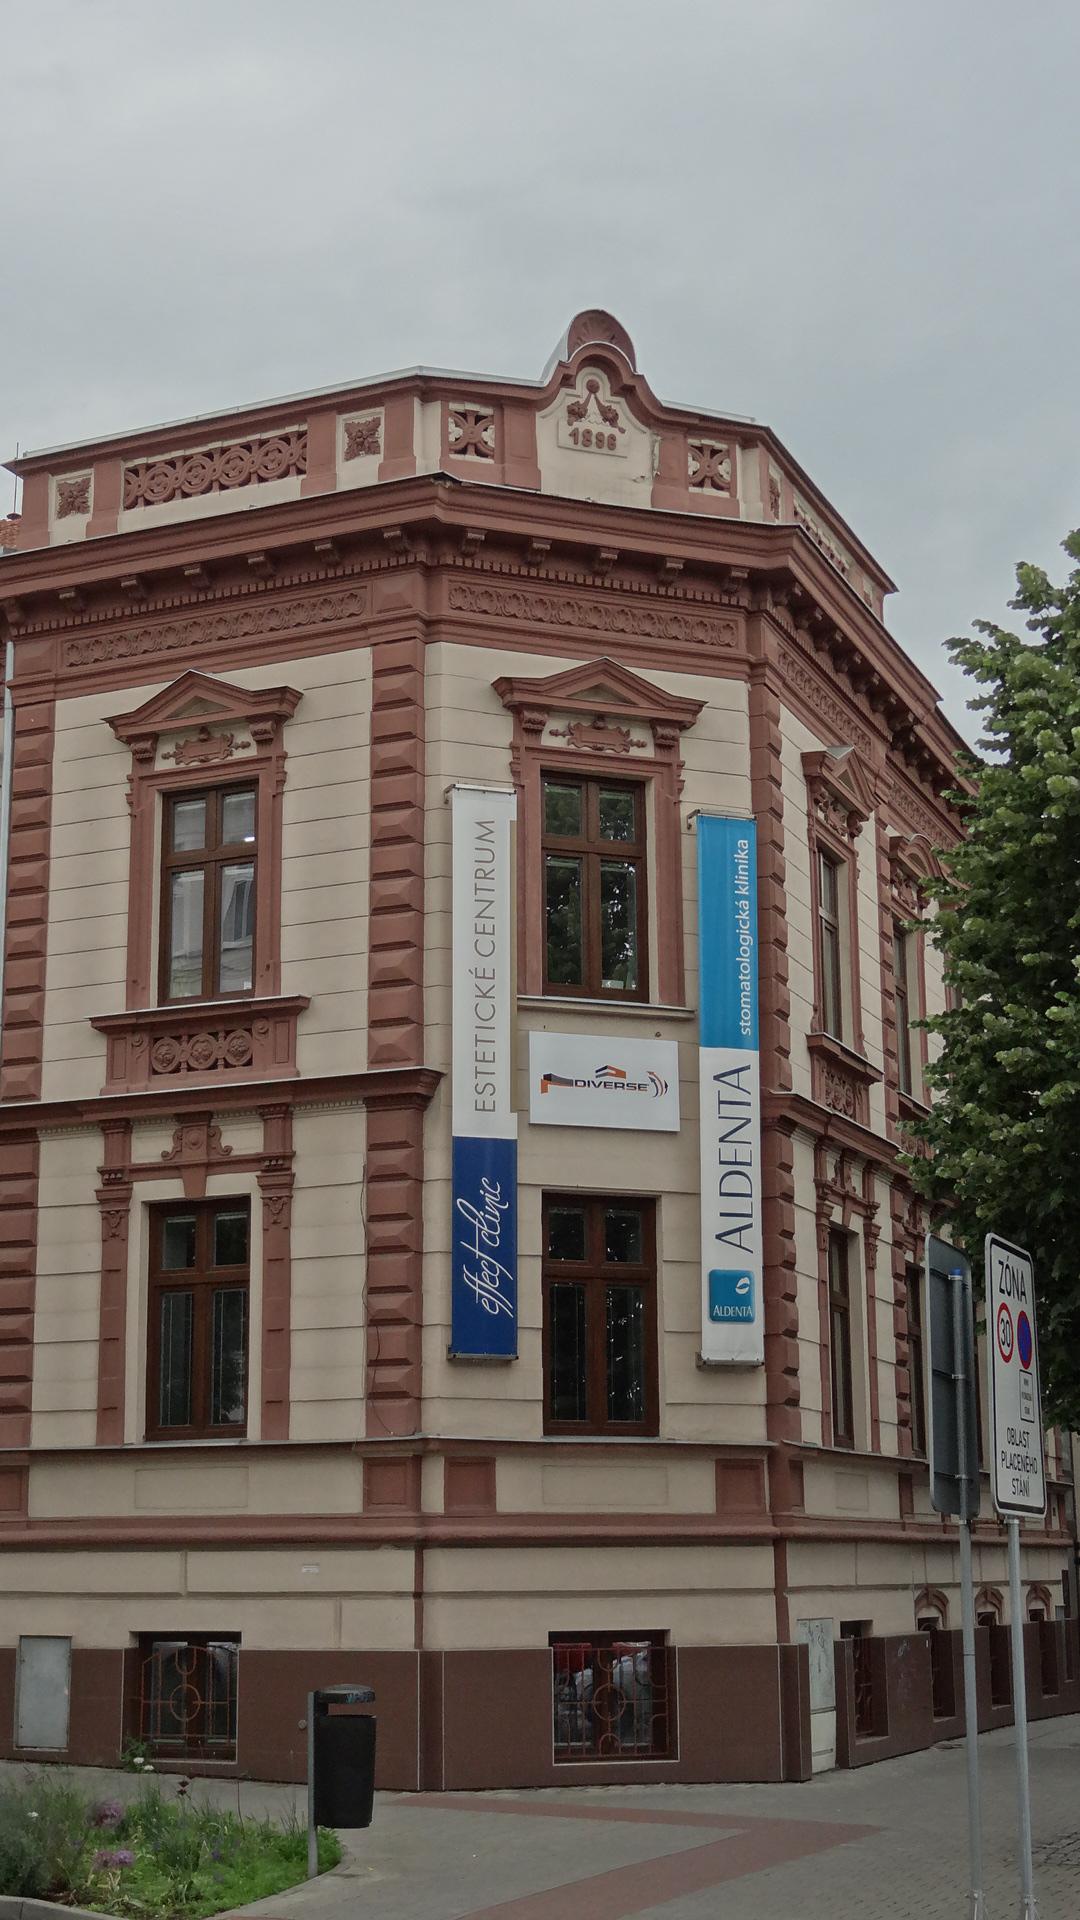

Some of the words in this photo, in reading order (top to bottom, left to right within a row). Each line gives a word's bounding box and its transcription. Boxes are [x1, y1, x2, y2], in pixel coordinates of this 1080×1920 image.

[474, 820, 496, 958] CENTRUM
[734, 839, 749, 898] klinika
[735, 900, 753, 1036] stomatologická
[468, 967, 496, 1112] ESTETICKÉ
[574, 1079, 648, 1091] DIVERSE
[713, 1064, 754, 1254] ALDENTA
[456, 1176, 509, 1247] clinic
[460, 1240, 514, 1318] effect
[998, 1255, 1028, 1305] ZÓNA
[713, 1304, 753, 1317] ALDENTA
[1000, 1317, 1011, 1348] 30
[1001, 1450, 1038, 1475] PLACENÉHO
[1006, 1427, 1030, 1449] OBLAST
[1011, 1476, 1030, 1498] STÁNÍ
